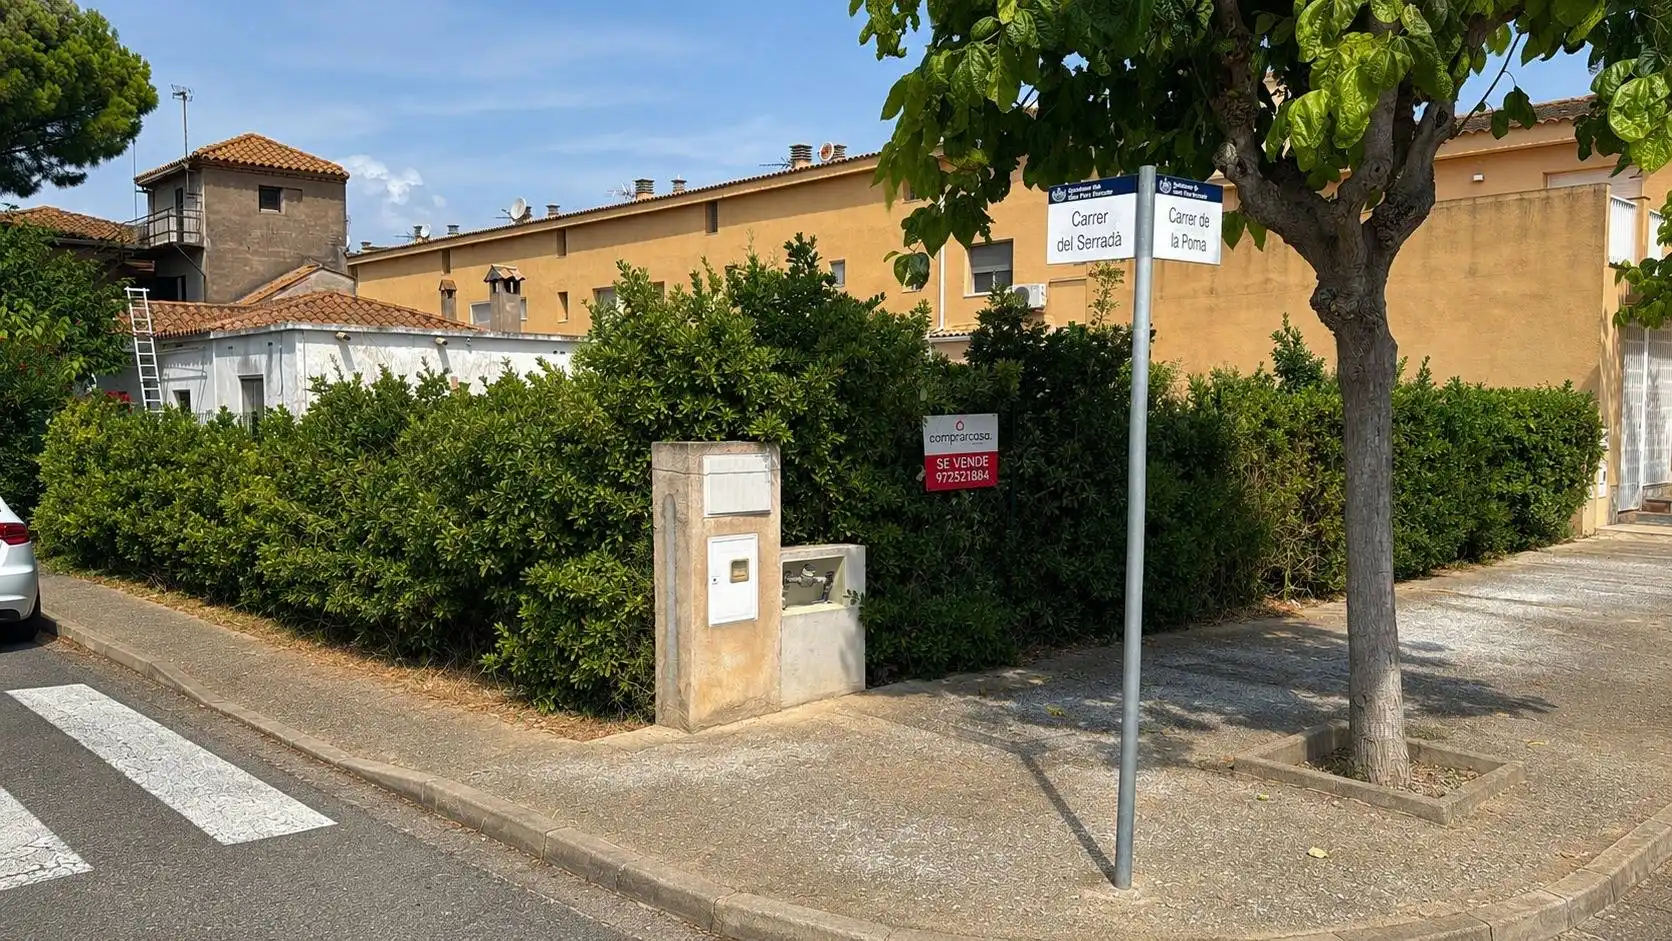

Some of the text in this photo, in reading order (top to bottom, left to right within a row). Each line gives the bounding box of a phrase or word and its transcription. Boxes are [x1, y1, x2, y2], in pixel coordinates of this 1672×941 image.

[1072, 210, 1109, 227] Carrer
[1169, 206, 1210, 229] Carrer de
[1057, 236, 1073, 252] del
[1171, 232, 1207, 252] la Poma
[936, 455, 989, 470] SE VENDE
[936, 469, 990, 484] 972521884
